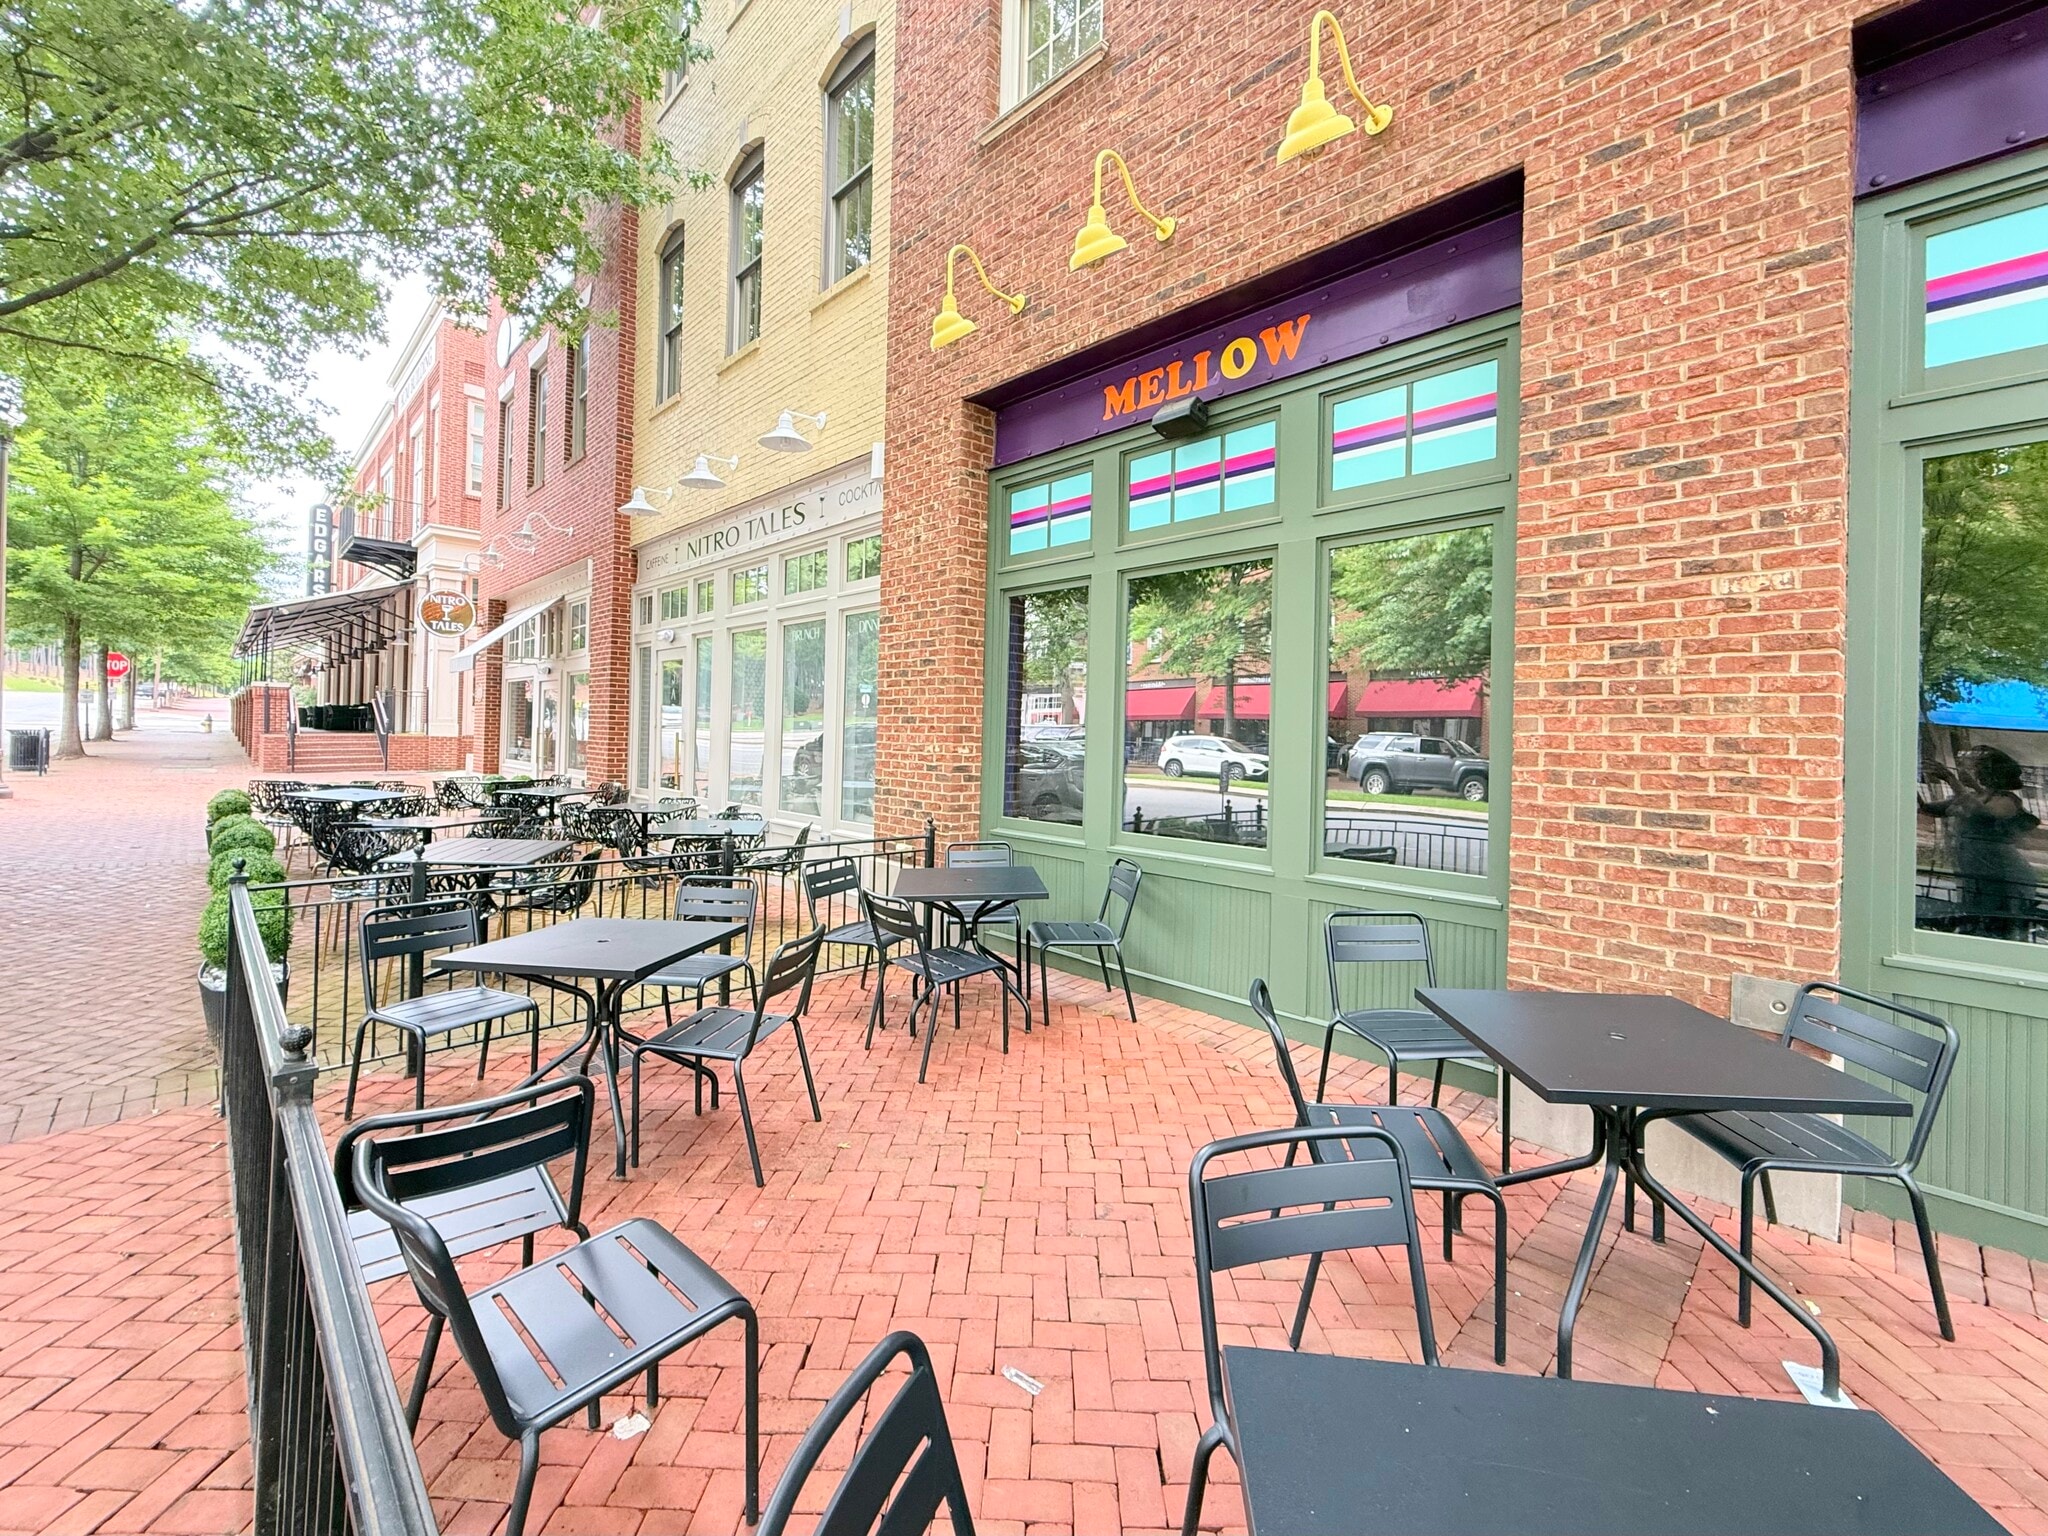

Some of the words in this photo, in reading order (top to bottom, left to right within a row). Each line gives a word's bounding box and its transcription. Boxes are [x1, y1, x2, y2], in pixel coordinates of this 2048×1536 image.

[687, 526, 740, 559] NITRO
[744, 502, 806, 541] TALES
[838, 481, 882, 506] COCKTA
[313, 508, 328, 597] EDGARS
[430, 594, 466, 606] NITRO
[430, 621, 465, 632] TALES
[858, 619, 879, 633] DINN
[792, 627, 820, 641] BRUNCH
[107, 660, 128, 671] TOP
